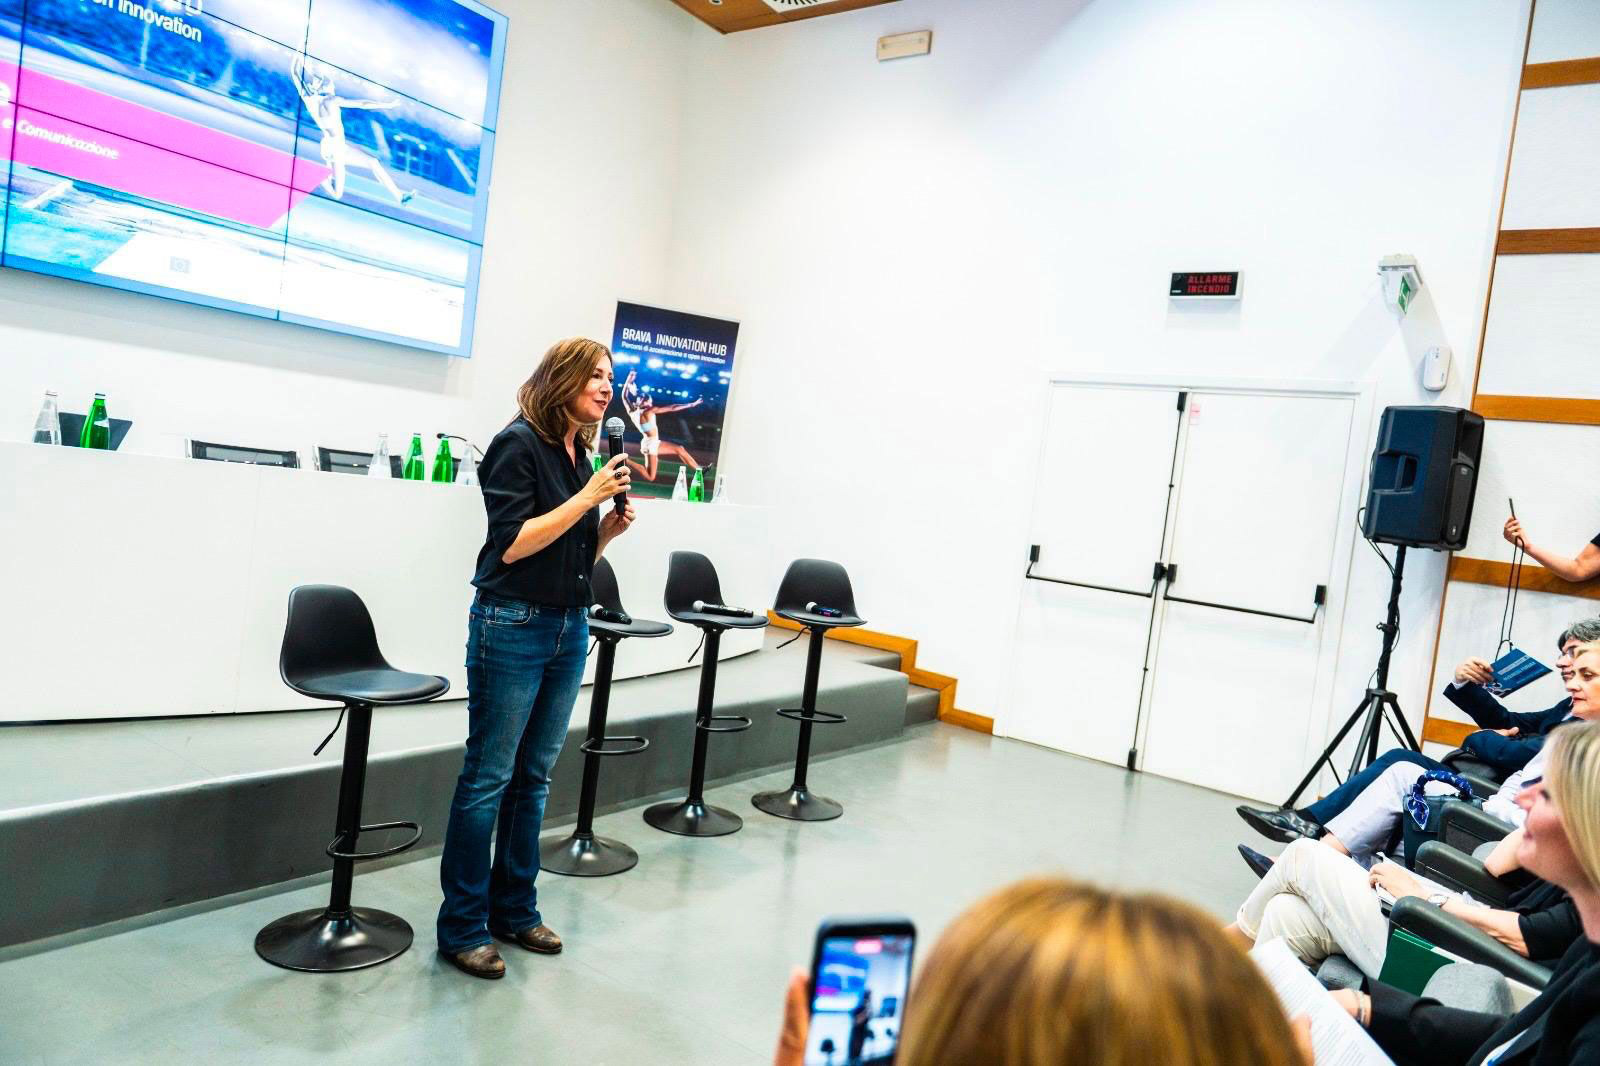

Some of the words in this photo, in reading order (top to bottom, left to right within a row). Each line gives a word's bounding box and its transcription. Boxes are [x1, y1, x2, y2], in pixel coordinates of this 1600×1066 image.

[117, 0, 202, 42] innovation
[1187, 285, 1230, 293] INCENDIO
[1188, 275, 1232, 284] ALLARME
[622, 327, 652, 344] BRAVA
[656, 333, 708, 353] INNOVATION
[708, 342, 727, 357] HUB
